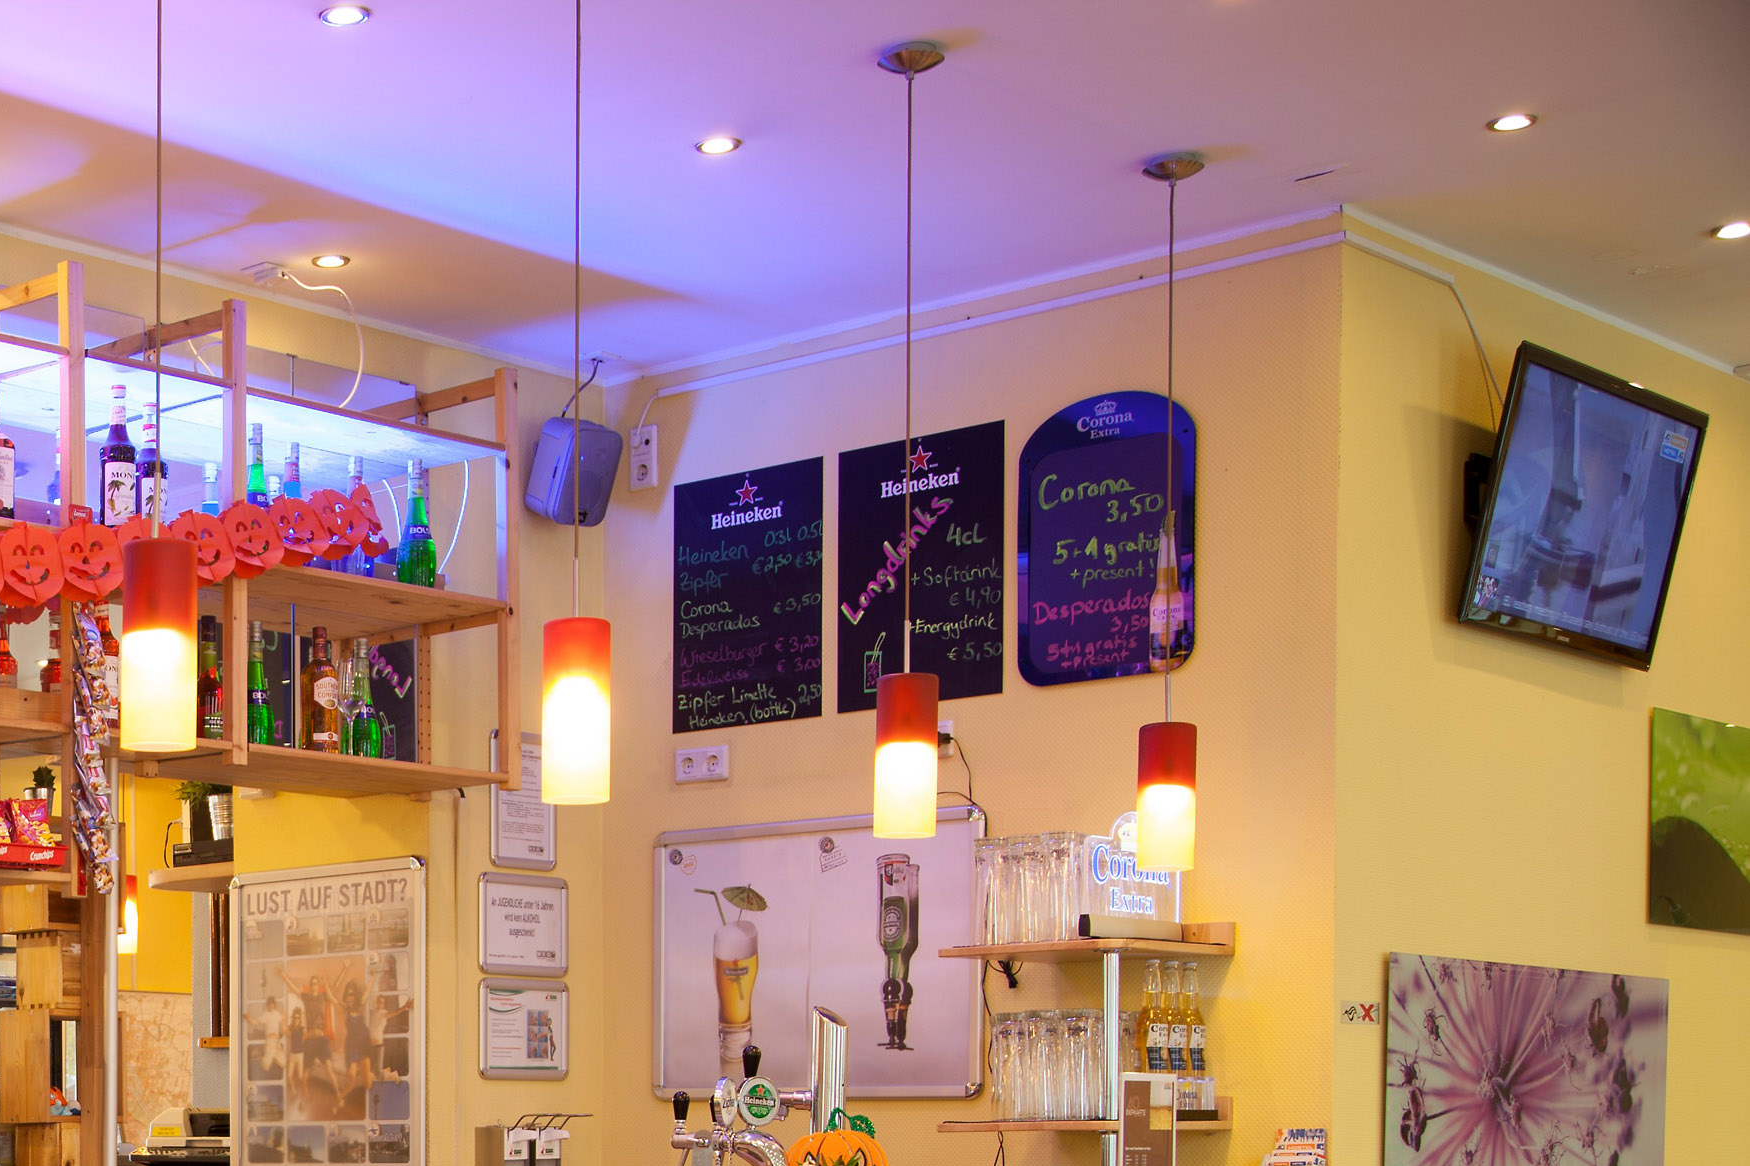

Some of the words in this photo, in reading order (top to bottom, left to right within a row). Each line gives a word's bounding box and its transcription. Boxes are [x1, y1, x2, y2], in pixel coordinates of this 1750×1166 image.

[1076, 411, 1133, 433] Corona
[1090, 427, 1120, 439] Extra
[879, 472, 960, 498] Heineken
[1038, 474, 1136, 510] Corona
[710, 502, 783, 530] Heineken
[1106, 494, 1164, 523] 3,50
[678, 541, 750, 568] Heineken
[841, 496, 953, 625] Longdrinks
[1104, 531, 1161, 566] gratis
[679, 569, 730, 597] Zipfer
[680, 600, 734, 619] Corona
[785, 593, 822, 612] 3,50
[965, 586, 1001, 609] 4,90
[1033, 587, 1150, 626] Desperados
[679, 614, 761, 640] Desperados
[963, 641, 1003, 662] 5,50
[678, 693, 726, 715] Zipfer
[689, 710, 746, 730] Heineken
[750, 697, 796, 724] (bottle)
[30, 849, 54, 862] Crunchips
[247, 890, 291, 916] LUST
[297, 885, 333, 911] AUF
[339, 878, 408, 908] STADT?
[1110, 887, 1154, 914] Extra
[744, 1095, 776, 1107] Heineken
